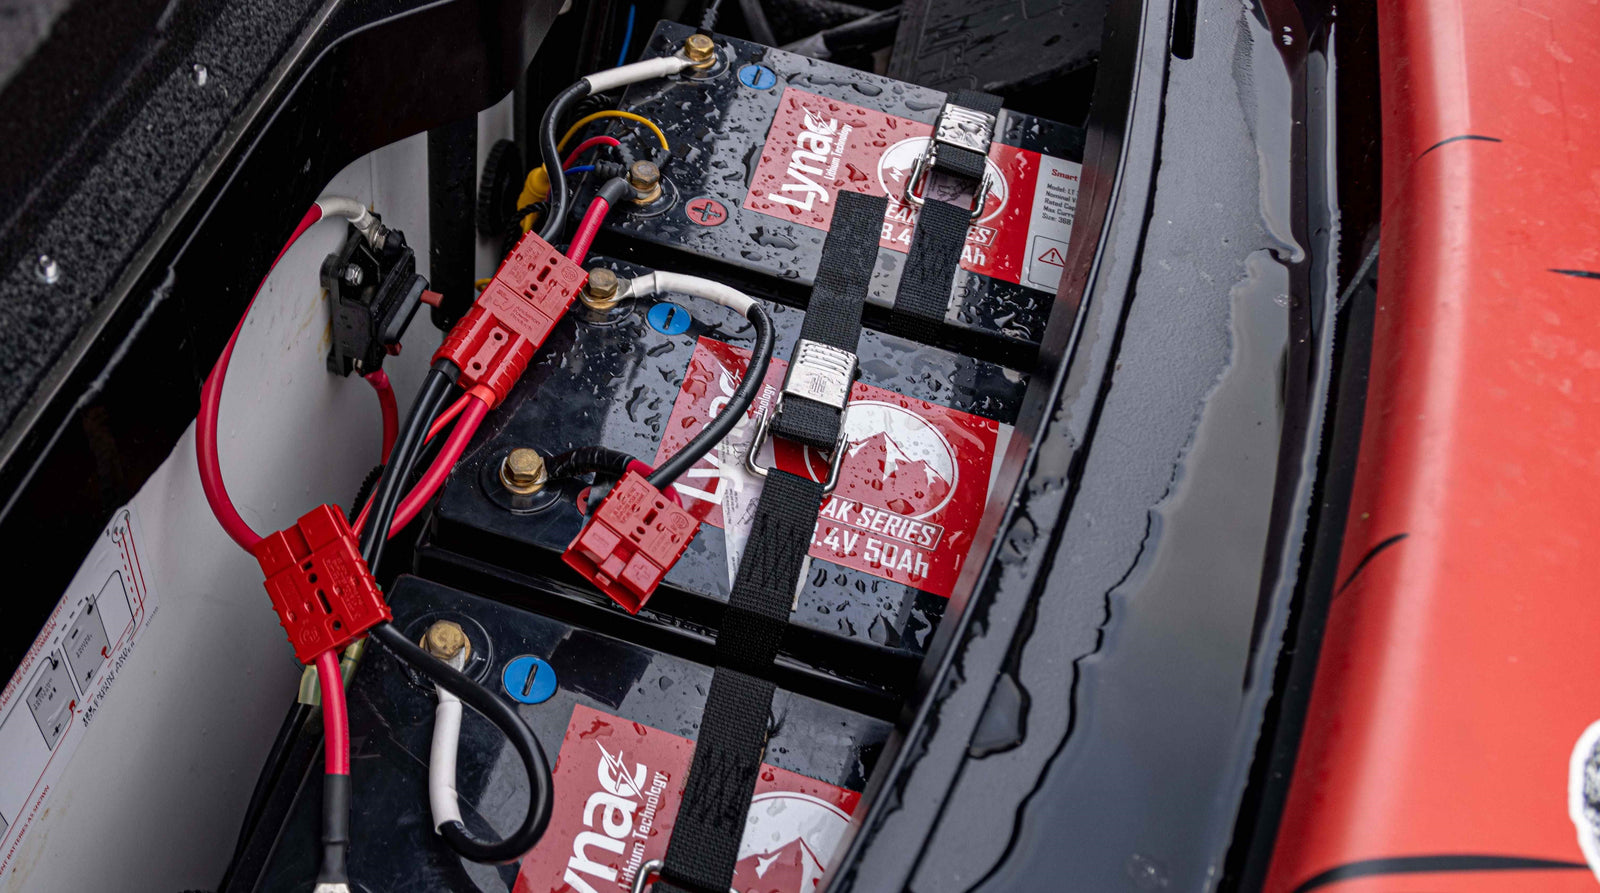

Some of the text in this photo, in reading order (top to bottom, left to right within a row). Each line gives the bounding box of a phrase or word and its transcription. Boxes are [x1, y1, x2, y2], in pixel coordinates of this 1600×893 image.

[768, 104, 838, 213] Lynac
[823, 123, 854, 182] Lithium Technology
[1051, 168, 1079, 182] Smart
[1045, 190, 1071, 202] Nominal
[1046, 183, 1066, 193] Model:
[885, 201, 918, 223] EAK
[1042, 205, 1056, 214] Max
[1044, 198, 1063, 208] Rated
[1041, 212, 1056, 221] Size:
[881, 222, 986, 266] 8.4 Ah
[821, 498, 936, 546] AK SERIES
[864, 538, 929, 578] 50Ah
[631, 772, 668, 839] Technology
